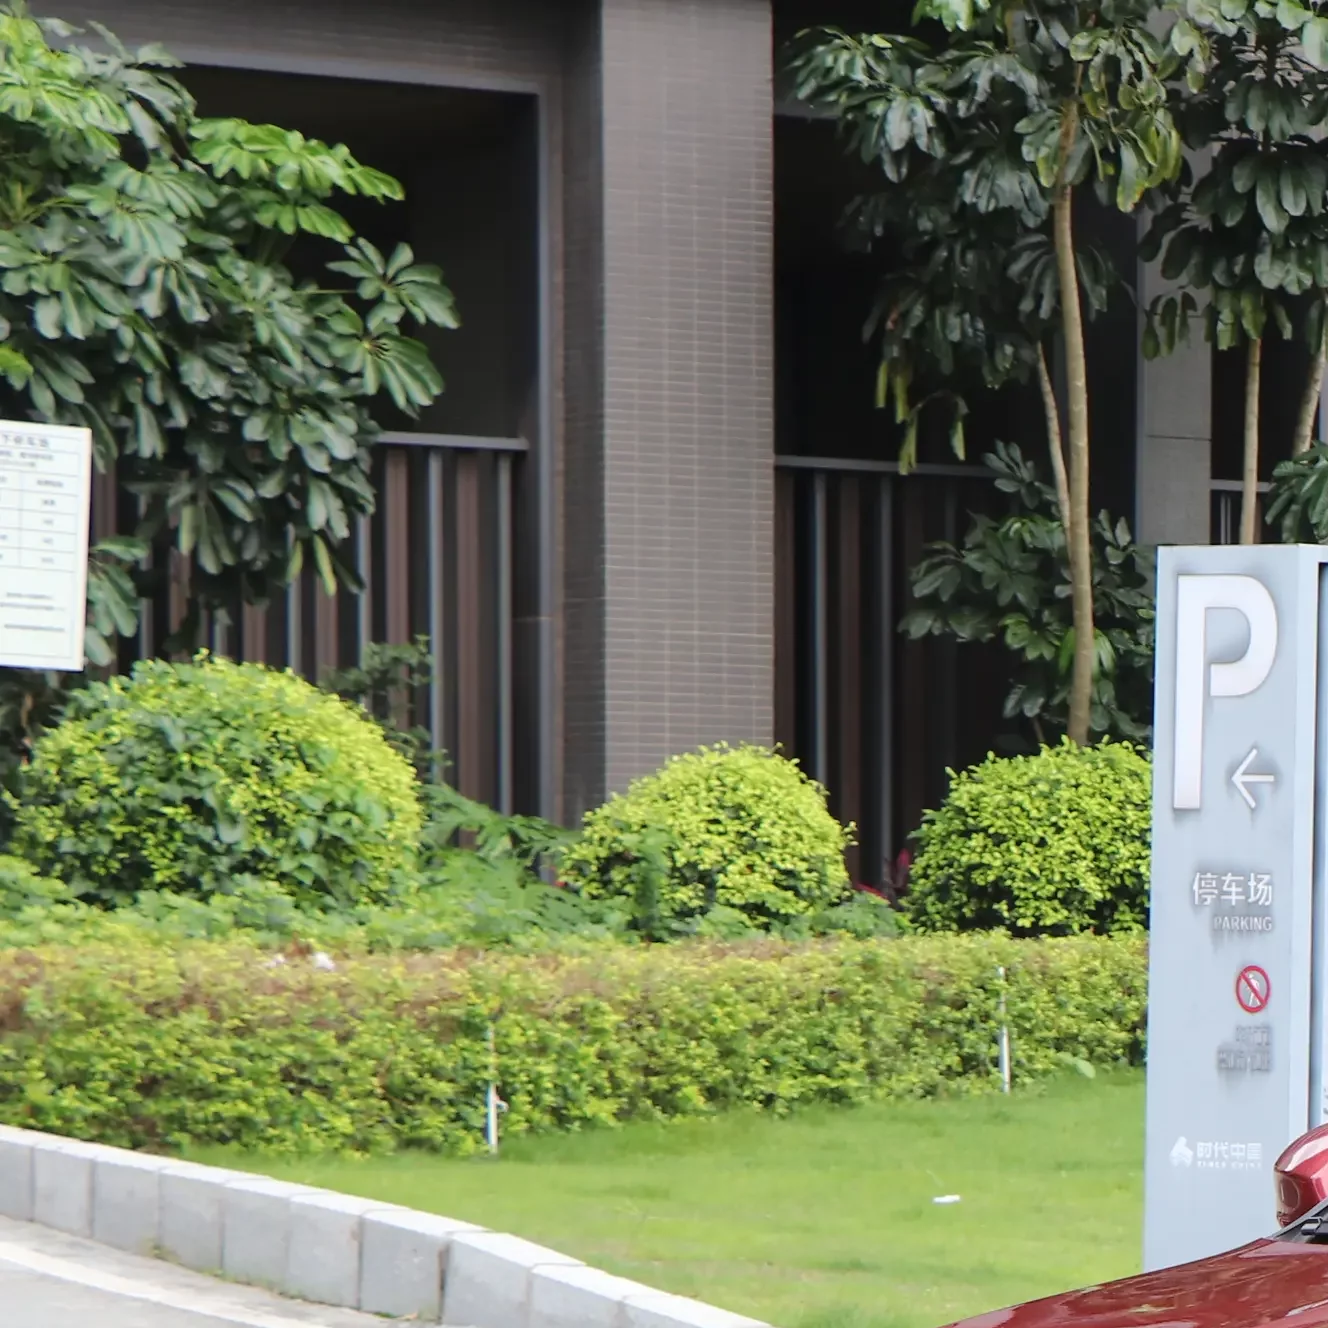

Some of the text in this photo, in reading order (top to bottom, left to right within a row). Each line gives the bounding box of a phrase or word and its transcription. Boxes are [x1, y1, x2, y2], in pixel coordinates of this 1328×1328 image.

[1173, 574, 1278, 810] P
[1193, 872, 1272, 906] 停车场
[1213, 916, 1272, 931] PARKING
[1196, 1141, 1262, 1160] 时代中国
